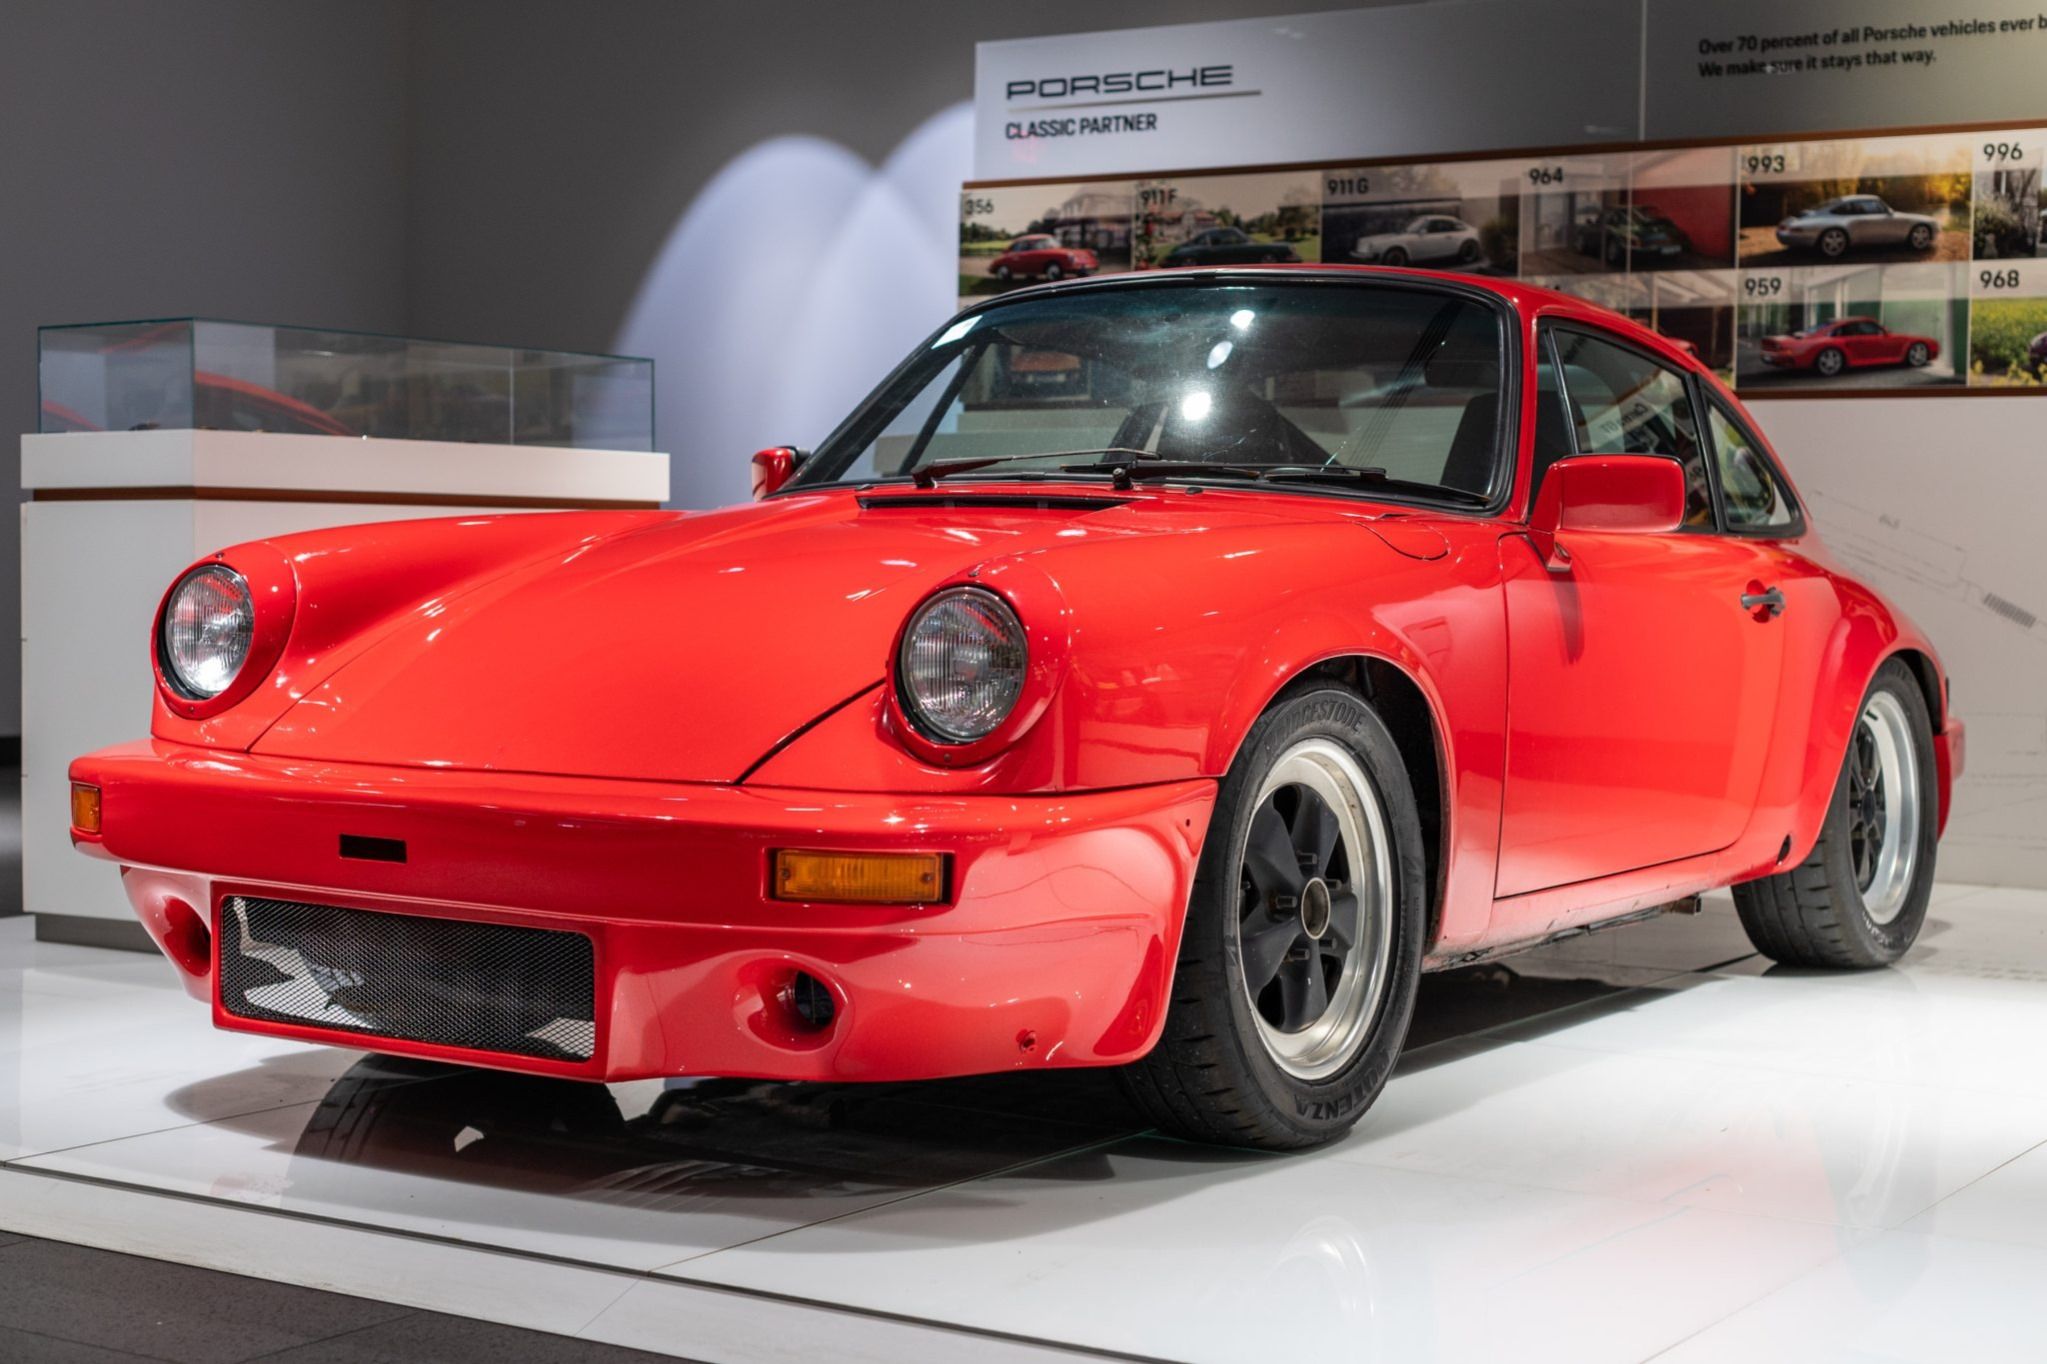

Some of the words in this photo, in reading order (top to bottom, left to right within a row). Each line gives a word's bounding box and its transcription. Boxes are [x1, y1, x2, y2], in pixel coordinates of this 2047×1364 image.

[1699, 38, 1733, 54] Over
[1737, 36, 1757, 50] 70
[1761, 33, 1818, 53] percent
[1822, 29, 1838, 44] of
[1842, 27, 1859, 43] all
[1864, 23, 1926, 42] Porsche
[1931, 18, 1996, 36] vehicles
[2000, 18, 2034, 31] ever
[1699, 61, 1722, 77] We
[1806, 54, 1816, 69] it
[1822, 53, 1862, 71] stays
[1867, 50, 1897, 65] that
[1902, 50, 1936, 66] way.
[1007, 65, 1233, 99] PORSCHE
[1005, 118, 1076, 139] CLASSIC
[1079, 113, 1158, 135] PARTNER
[1983, 143, 2023, 162] 996
[1747, 155, 1785, 174] 993
[1529, 167, 1564, 185] 964
[966, 199, 994, 215] 356
[1745, 277, 1782, 296] 959
[1980, 269, 2020, 289] 968
